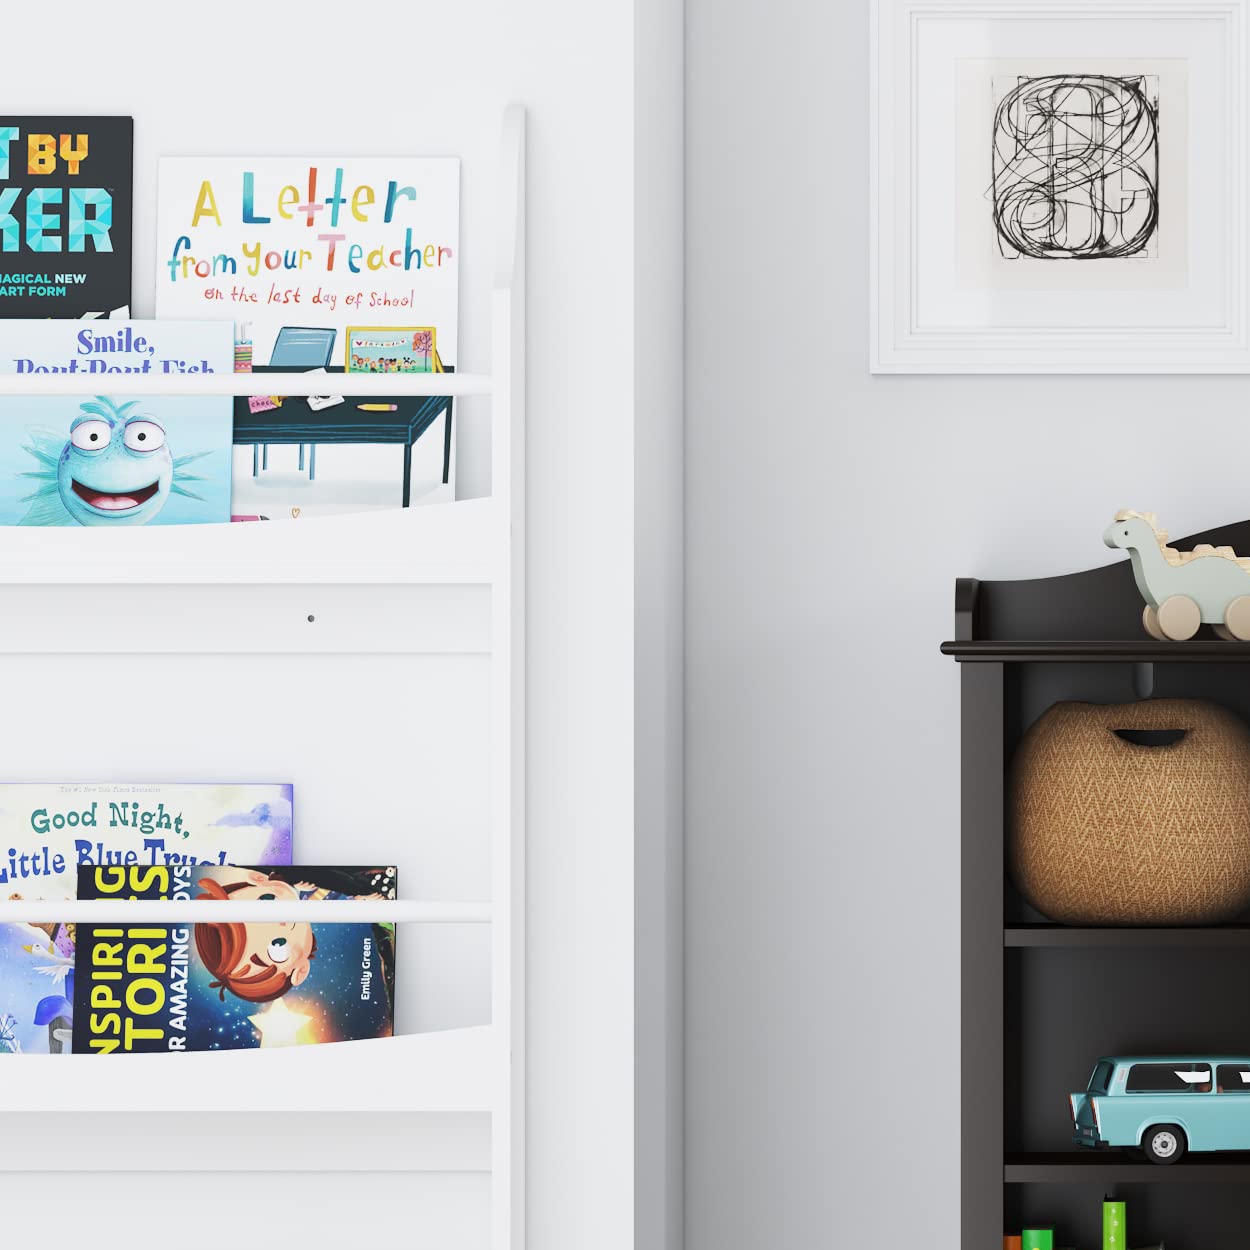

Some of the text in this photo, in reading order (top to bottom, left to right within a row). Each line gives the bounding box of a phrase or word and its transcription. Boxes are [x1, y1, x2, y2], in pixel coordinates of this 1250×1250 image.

[27, 134, 89, 175] BY
[192, 167, 417, 228] A Letter
[167, 227, 453, 282] from your Teacher
[0, 273, 87, 284] AGICAL NEW
[0, 286, 67, 297] ART FORM
[203, 287, 224, 300] on
[230, 285, 258, 303] the
[267, 282, 301, 304] last
[312, 287, 337, 311] day
[345, 293, 363, 310] of
[77, 327, 155, 357] Smile,
[31, 801, 191, 840] Good Night,
[168, 928, 190, 1031] AMAZING
[361, 937, 373, 1001] Emily Green
